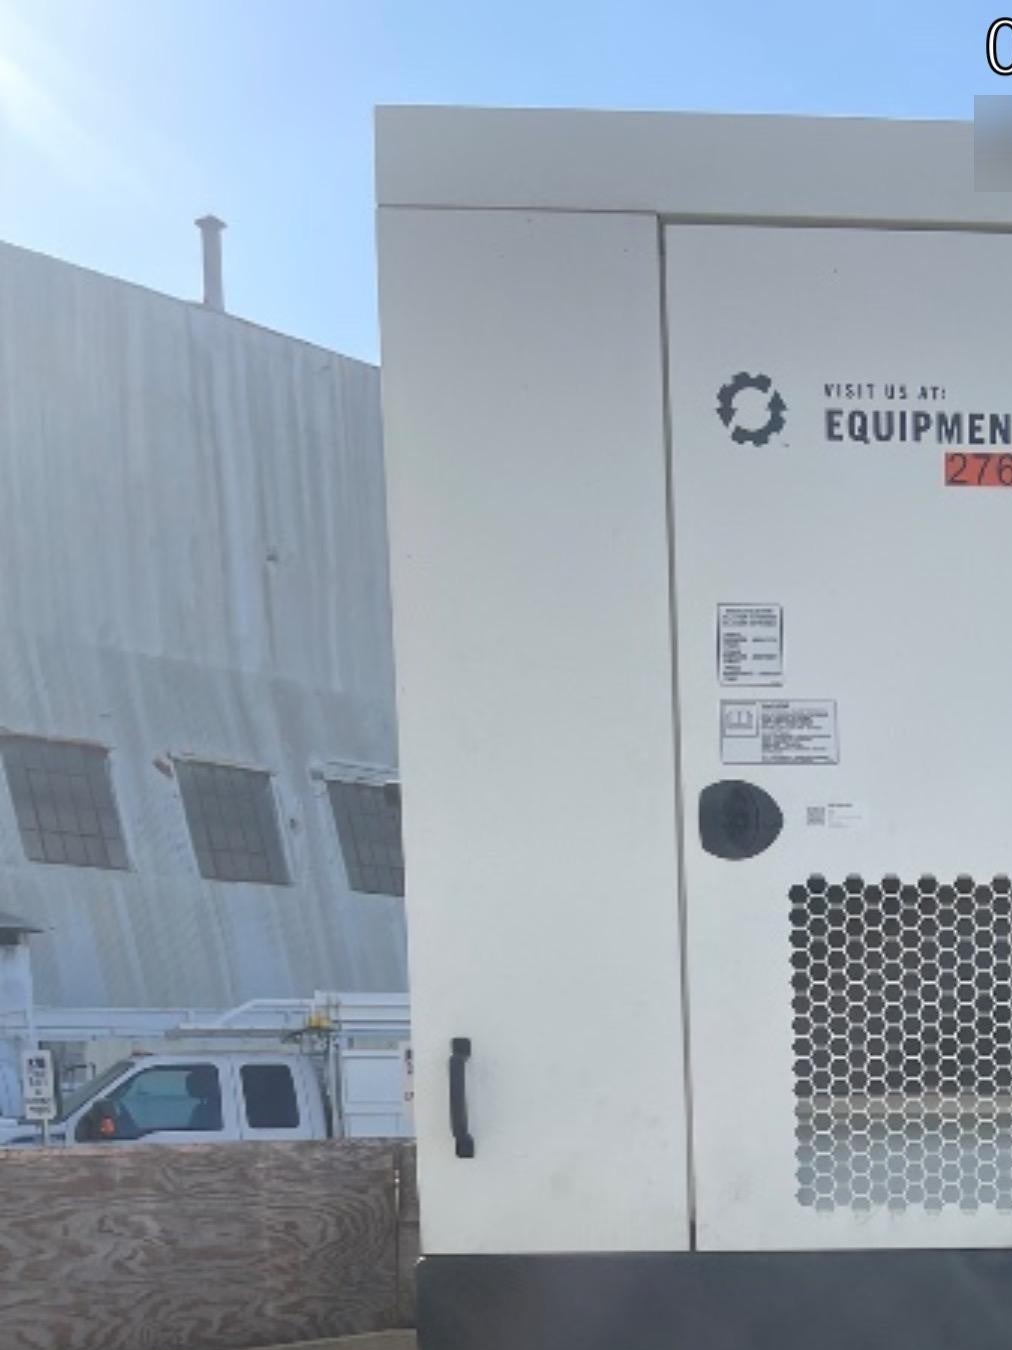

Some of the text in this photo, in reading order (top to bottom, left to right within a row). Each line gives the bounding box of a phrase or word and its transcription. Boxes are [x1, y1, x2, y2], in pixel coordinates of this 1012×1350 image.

[823, 383, 946, 401] VISIT US AT:
